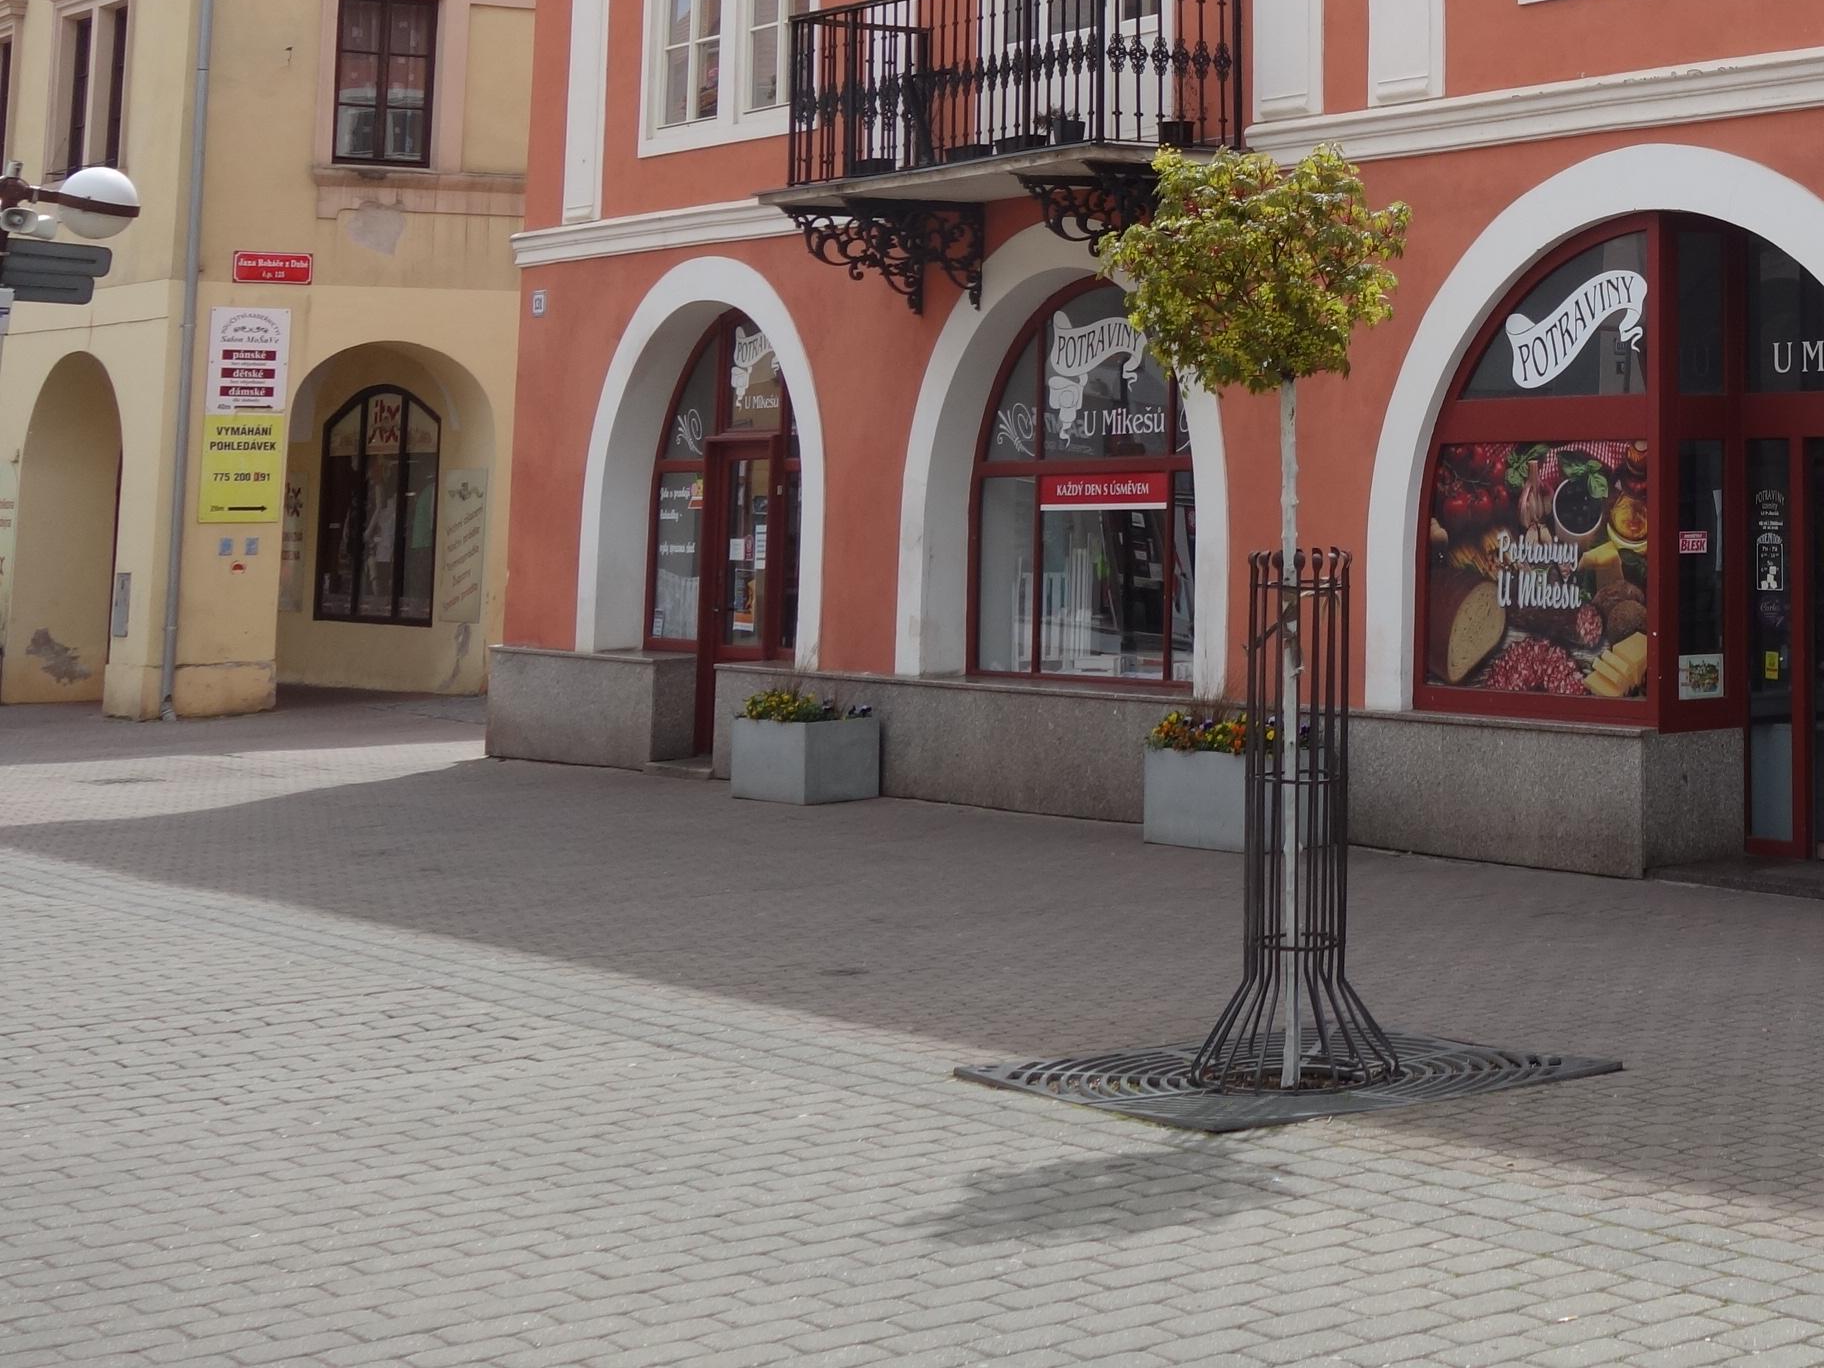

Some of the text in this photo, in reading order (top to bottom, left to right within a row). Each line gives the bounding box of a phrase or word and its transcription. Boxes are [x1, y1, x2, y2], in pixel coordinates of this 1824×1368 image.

[1518, 276, 1635, 381] POTRAVINY
[1056, 322, 1139, 369] POTRAVINY
[232, 350, 267, 360] pánské
[1773, 341, 1793, 373] U
[233, 369, 264, 378] dětské
[228, 387, 266, 396] dámské
[744, 395, 751, 410] U
[1084, 410, 1096, 437] U
[1102, 406, 1165, 436] Mikešů
[216, 423, 273, 436] VYMÁHÁNÍ
[209, 439, 277, 451] POHLEDÁVEK
[213, 472, 230, 482] 775
[234, 472, 251, 482] 200
[1056, 479, 1149, 497] KAŽDÝ DEN S ÚSMĚVEM
[1755, 489, 1785, 505] POTRAVINY
[1497, 530, 1578, 572] Potraviny
[1681, 539, 1706, 551] BLESK
[1497, 570, 1512, 607] U
